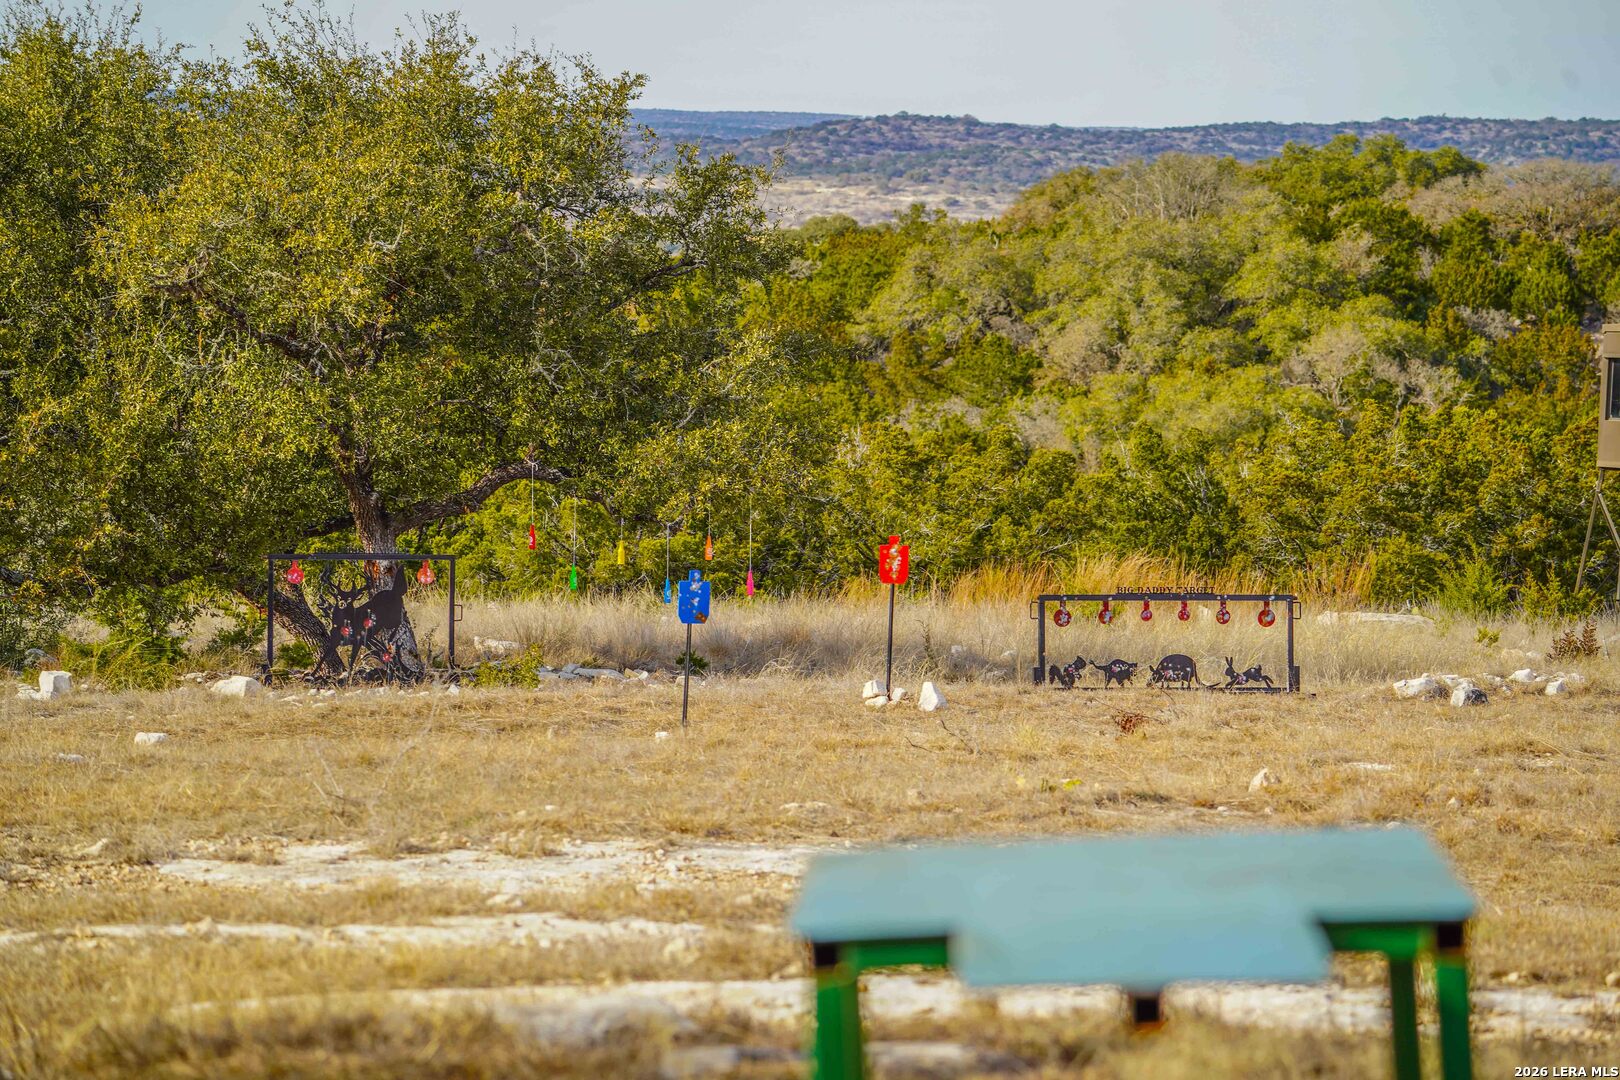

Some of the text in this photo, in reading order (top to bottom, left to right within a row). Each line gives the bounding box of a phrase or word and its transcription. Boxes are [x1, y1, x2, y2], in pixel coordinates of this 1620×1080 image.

[1117, 586, 1215, 594] BIG DADDY TARGET
